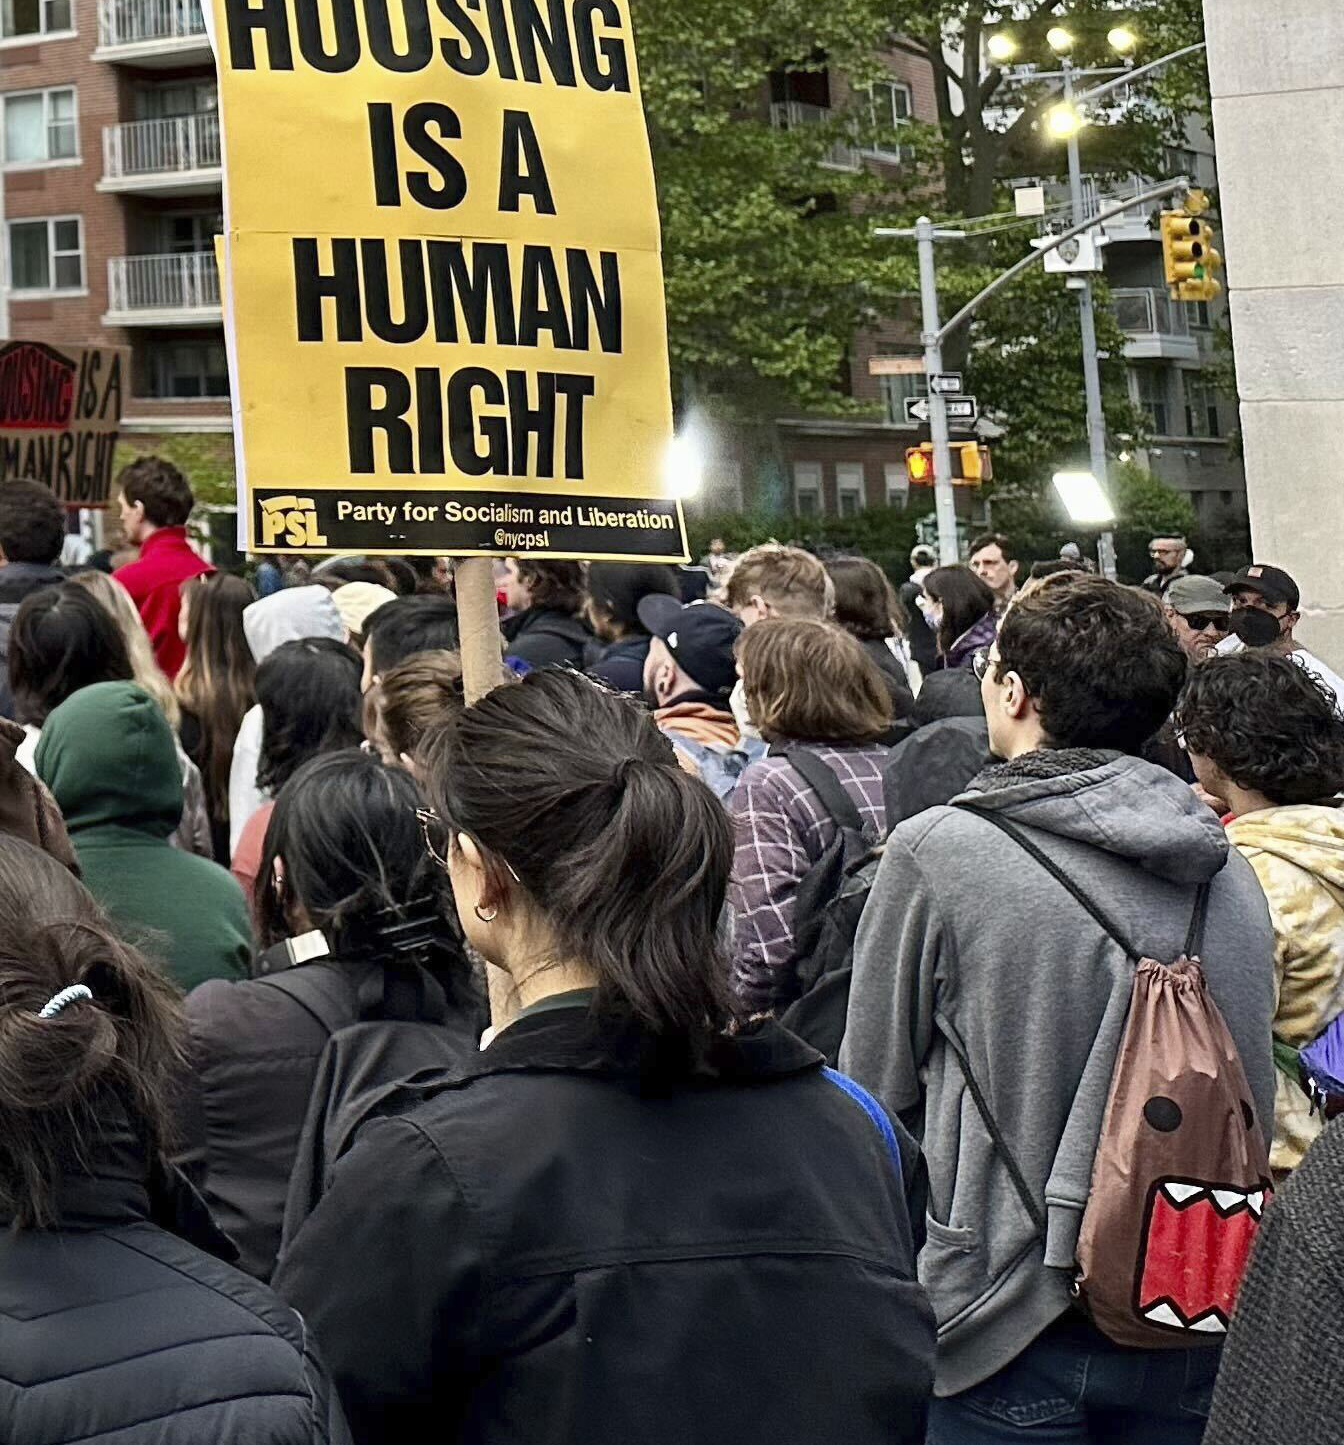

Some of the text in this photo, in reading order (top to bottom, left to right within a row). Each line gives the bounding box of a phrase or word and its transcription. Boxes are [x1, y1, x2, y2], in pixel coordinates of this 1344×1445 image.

[367, 101, 557, 216] IS A
[291, 236, 623, 354] HUMAN
[75, 350, 122, 421] IS A
[343, 365, 595, 480] RIGHT
[56, 430, 119, 502] RIGHT
[262, 500, 674, 547] PSL Party for Socialism and Liberation
[494, 529, 550, 548] @nycpsl
